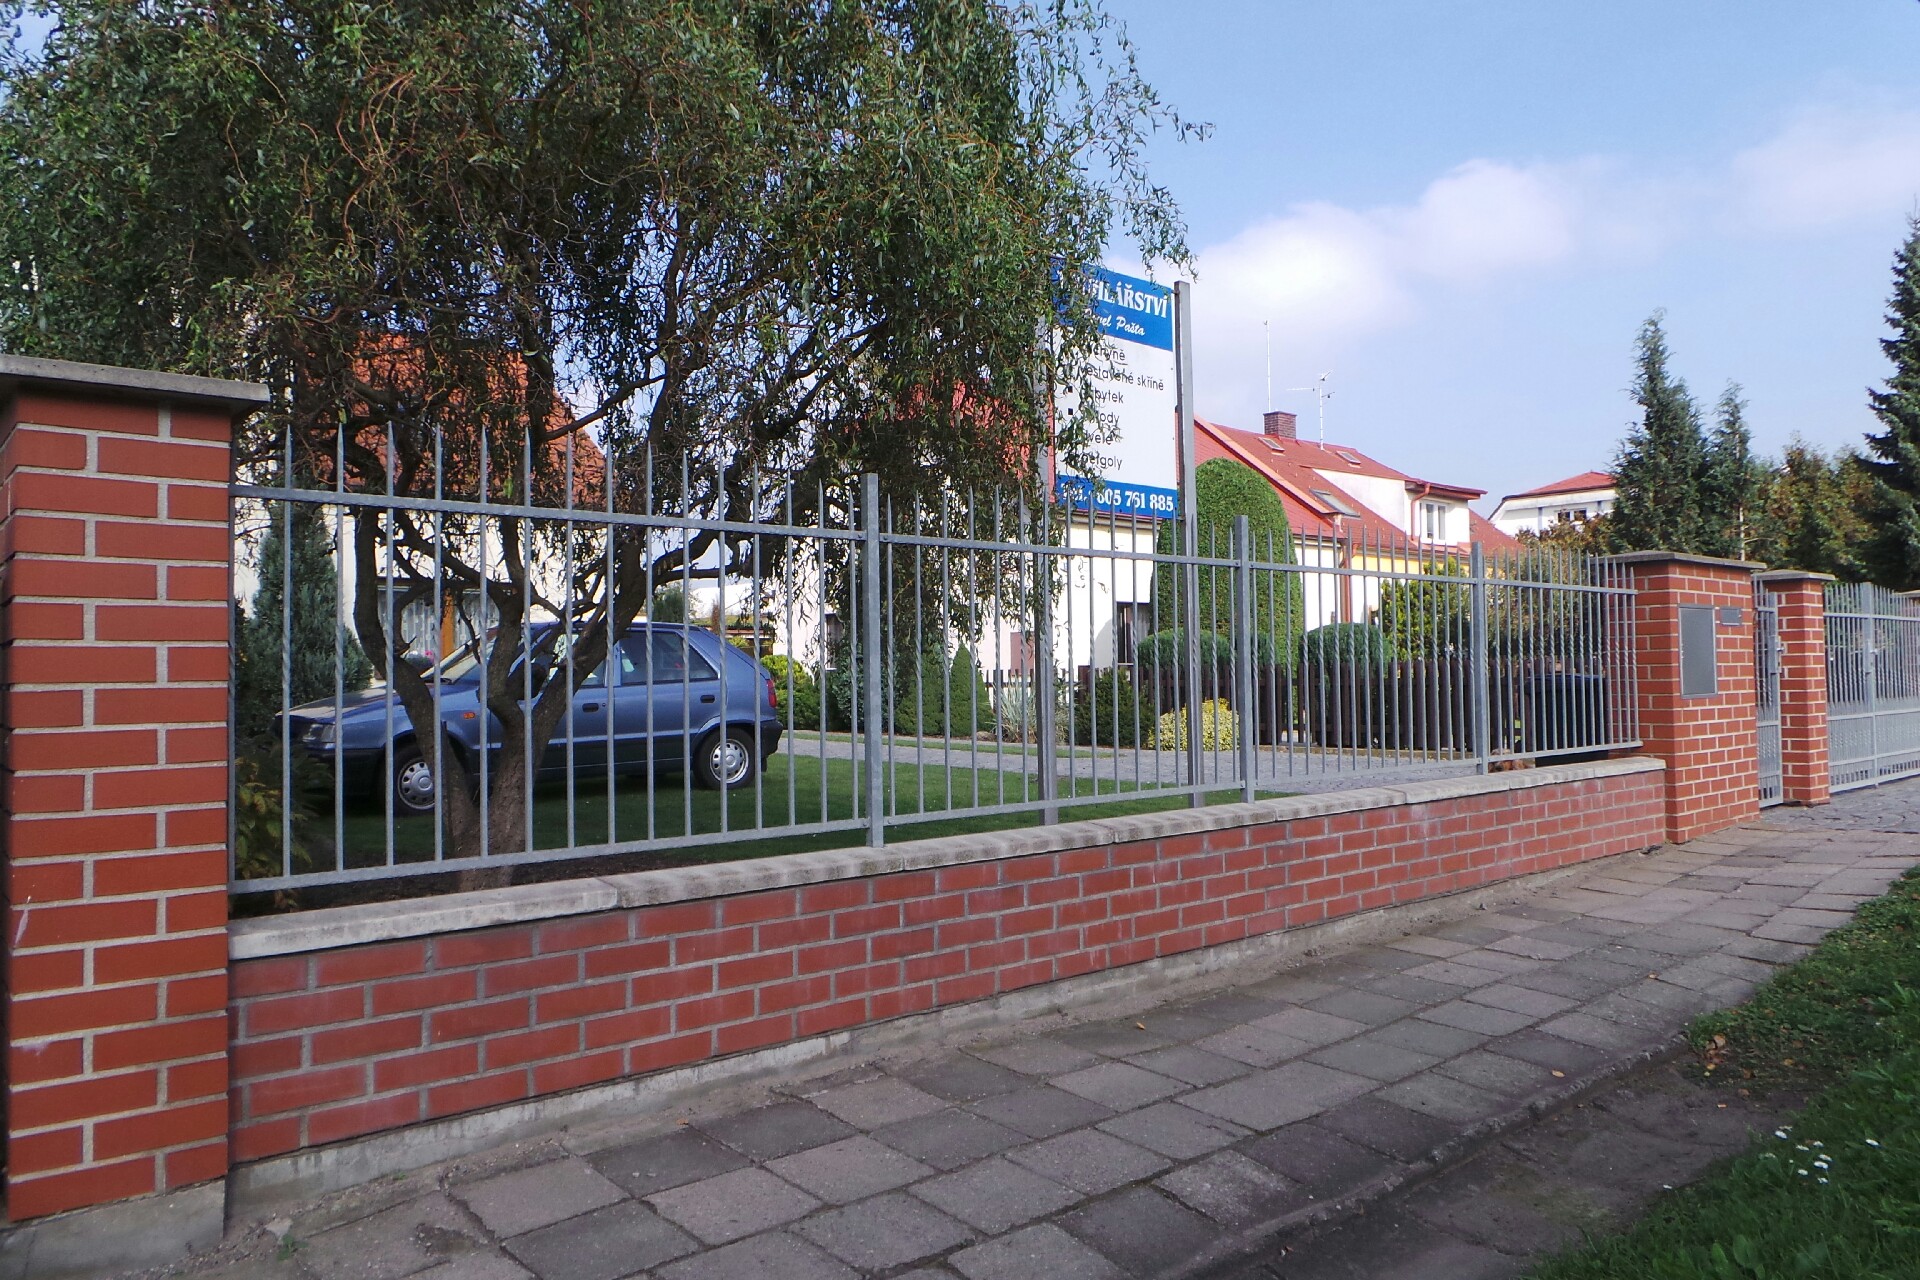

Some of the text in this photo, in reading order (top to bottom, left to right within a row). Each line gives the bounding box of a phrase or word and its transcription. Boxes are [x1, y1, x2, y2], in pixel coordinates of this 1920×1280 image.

[1116, 315, 1146, 336] Pašta
[1137, 374, 1164, 391] skříně
[1096, 487, 1122, 506] 605
[1125, 490, 1146, 509] 761
[1149, 493, 1174, 512] 885
